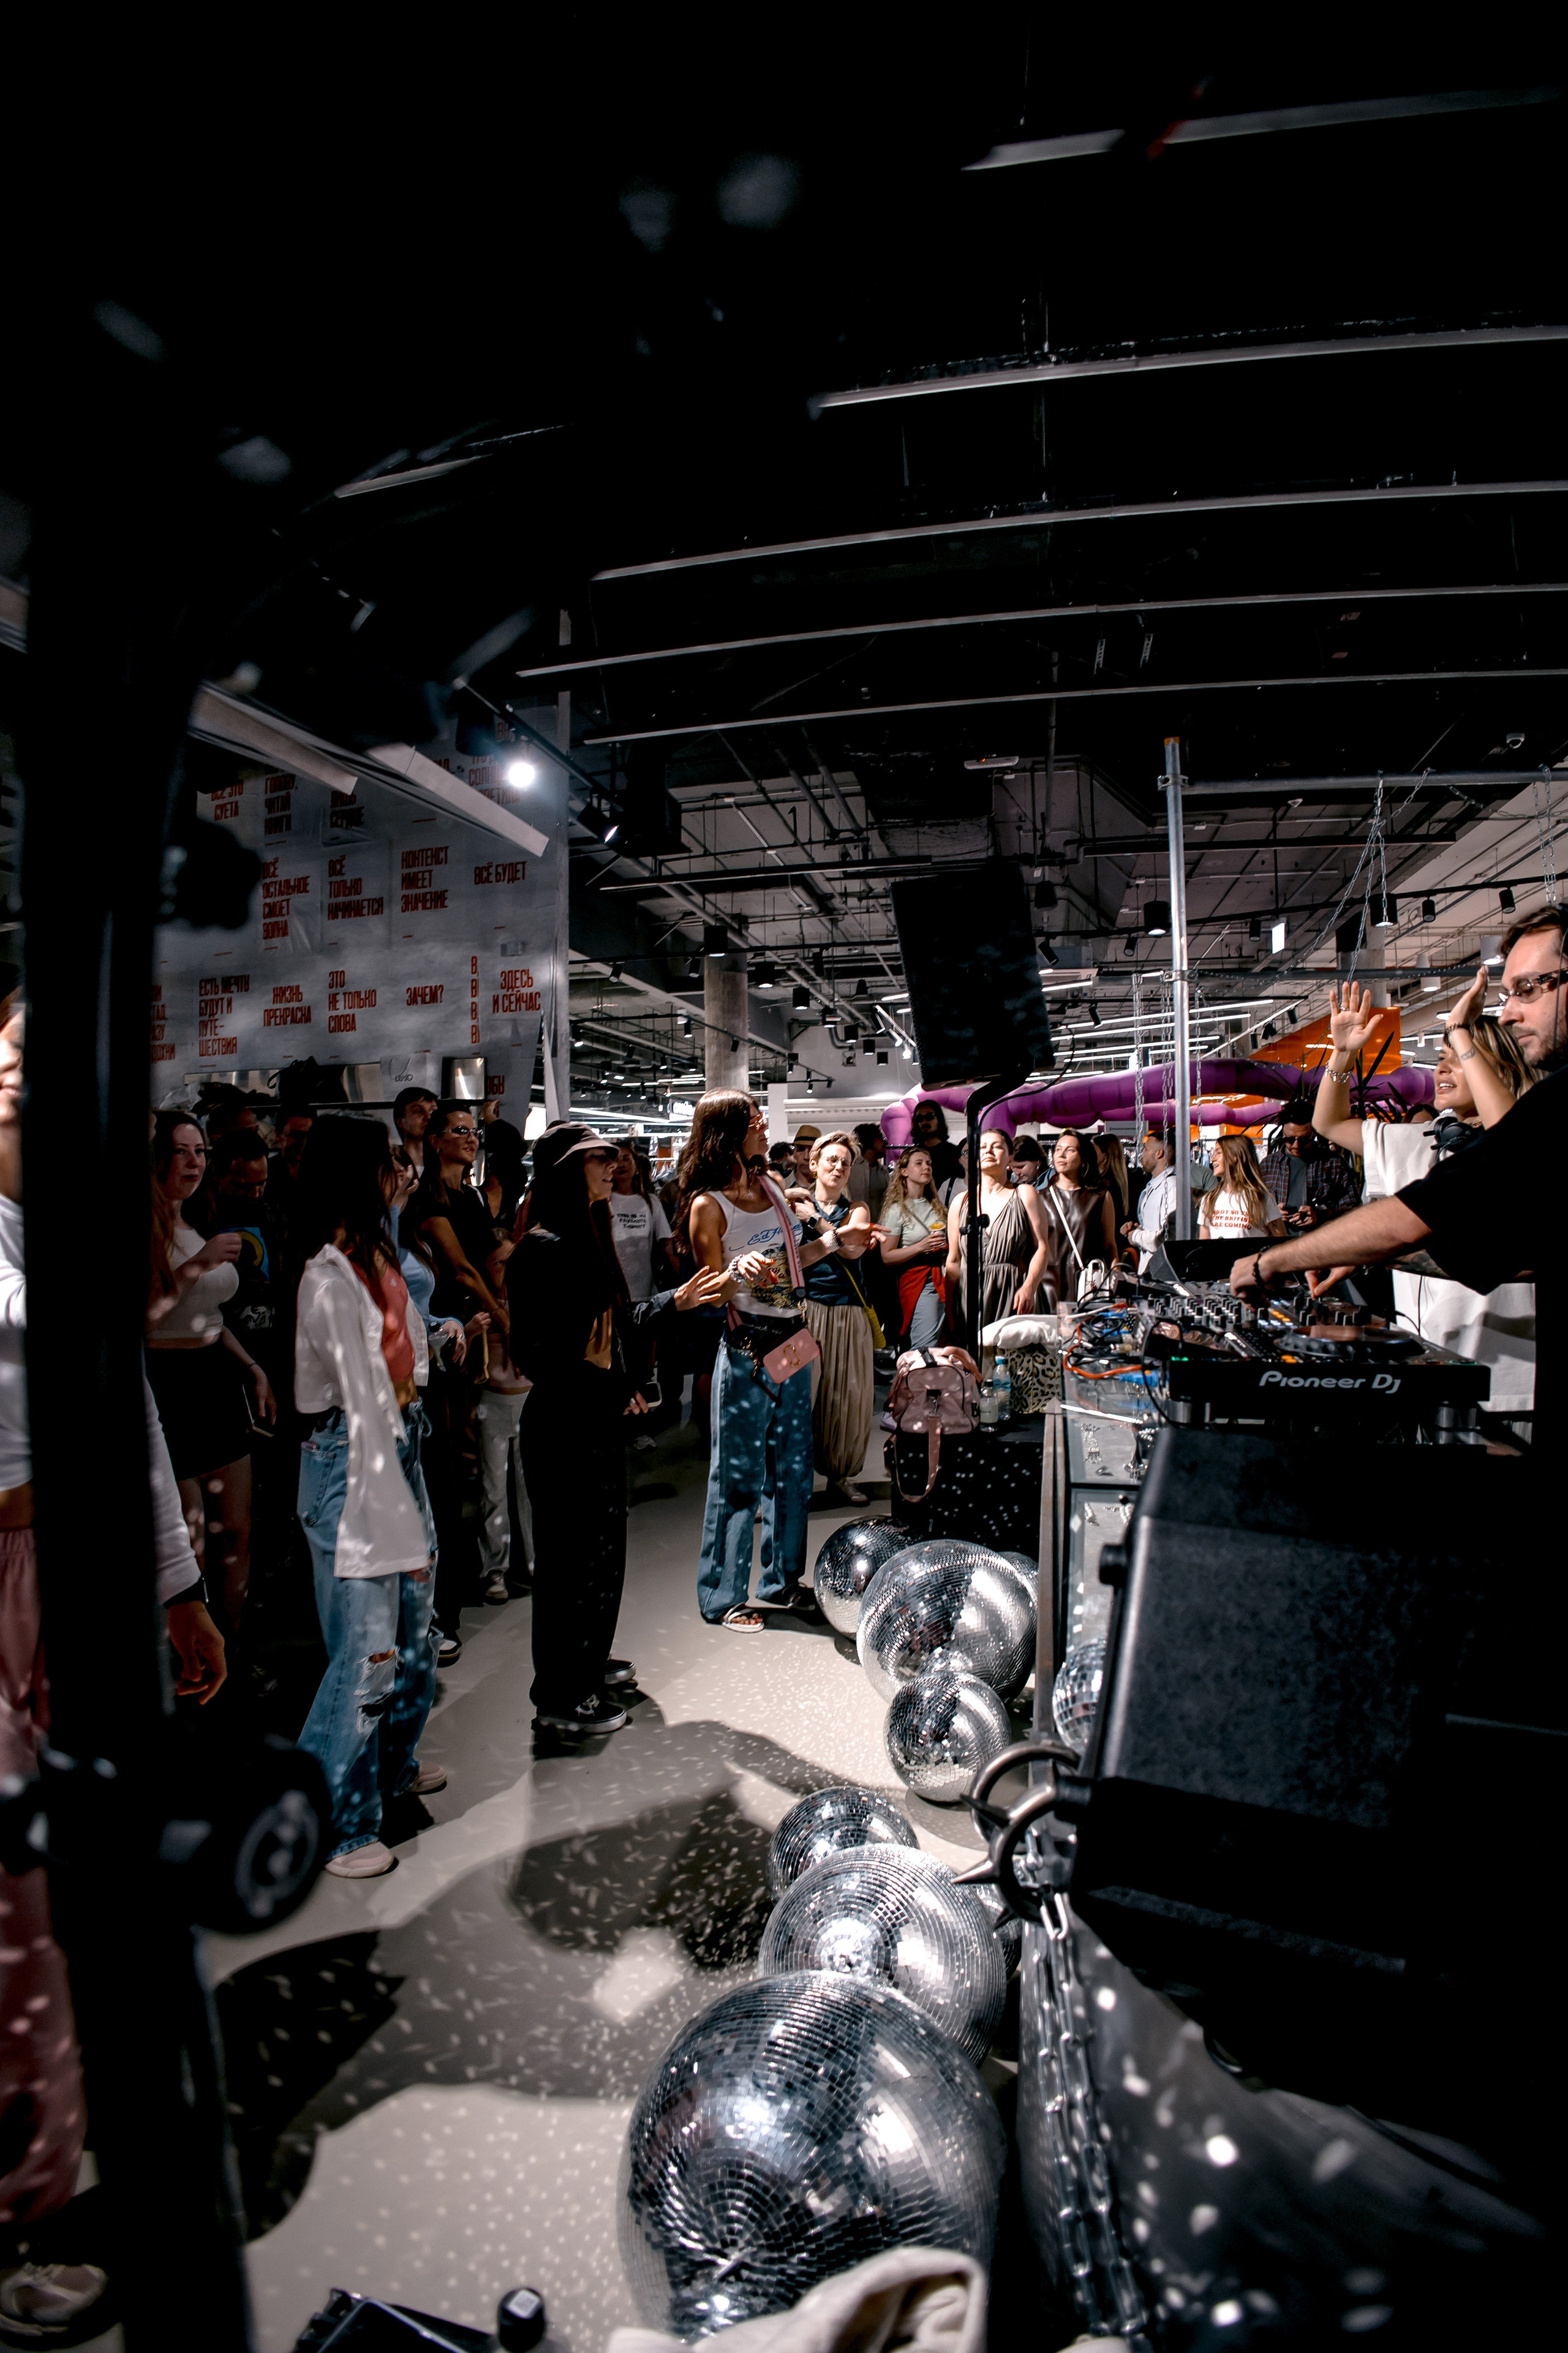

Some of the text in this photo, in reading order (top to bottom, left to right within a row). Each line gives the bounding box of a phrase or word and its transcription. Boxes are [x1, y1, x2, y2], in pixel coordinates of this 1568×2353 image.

[214, 800, 239, 821] СУЕТА
[262, 857, 279, 880] ВСЁ
[328, 855, 346, 877] ВСЁ
[401, 846, 449, 870] КОНТЕКСТ
[401, 869, 433, 890] ИМЕЕТ
[474, 861, 527, 885] ВСЁ БУДЕТ
[262, 876, 310, 899] ОСТАЛЬНОЕ
[328, 878, 362, 899] ТОЛЬКО
[263, 899, 290, 920] СМОЕТ
[327, 897, 384, 921] НАЧИНАЕТСЯ
[401, 889, 448, 913] ЗНАЧЕНИЕ
[263, 920, 288, 940] ВОЛНА
[199, 978, 219, 997] ЕСТЬ
[328, 970, 345, 989] ЭТО
[500, 969, 533, 992] ЗДЕСЬ
[273, 984, 303, 1005] ЖИЗНЬ
[328, 989, 377, 1011] НЕ ТОЛЬКО
[406, 984, 444, 1006] ЗАЧЕМ?
[492, 990, 541, 1014] И СЕЙЧАС
[199, 997, 232, 1018] БУДУТ И
[263, 1005, 312, 1027] ПРЕКРАСНА
[199, 1018, 225, 1037] ПУТЕ-
[328, 1013, 356, 1033] СЛОВА
[150, 1043, 175, 1063] ДОХНИ
[199, 1037, 238, 1057] ШЕСТВИЯ
[486, 1075, 505, 1095] ОБЫ
[1259, 1370, 1366, 1388] Pioneer
